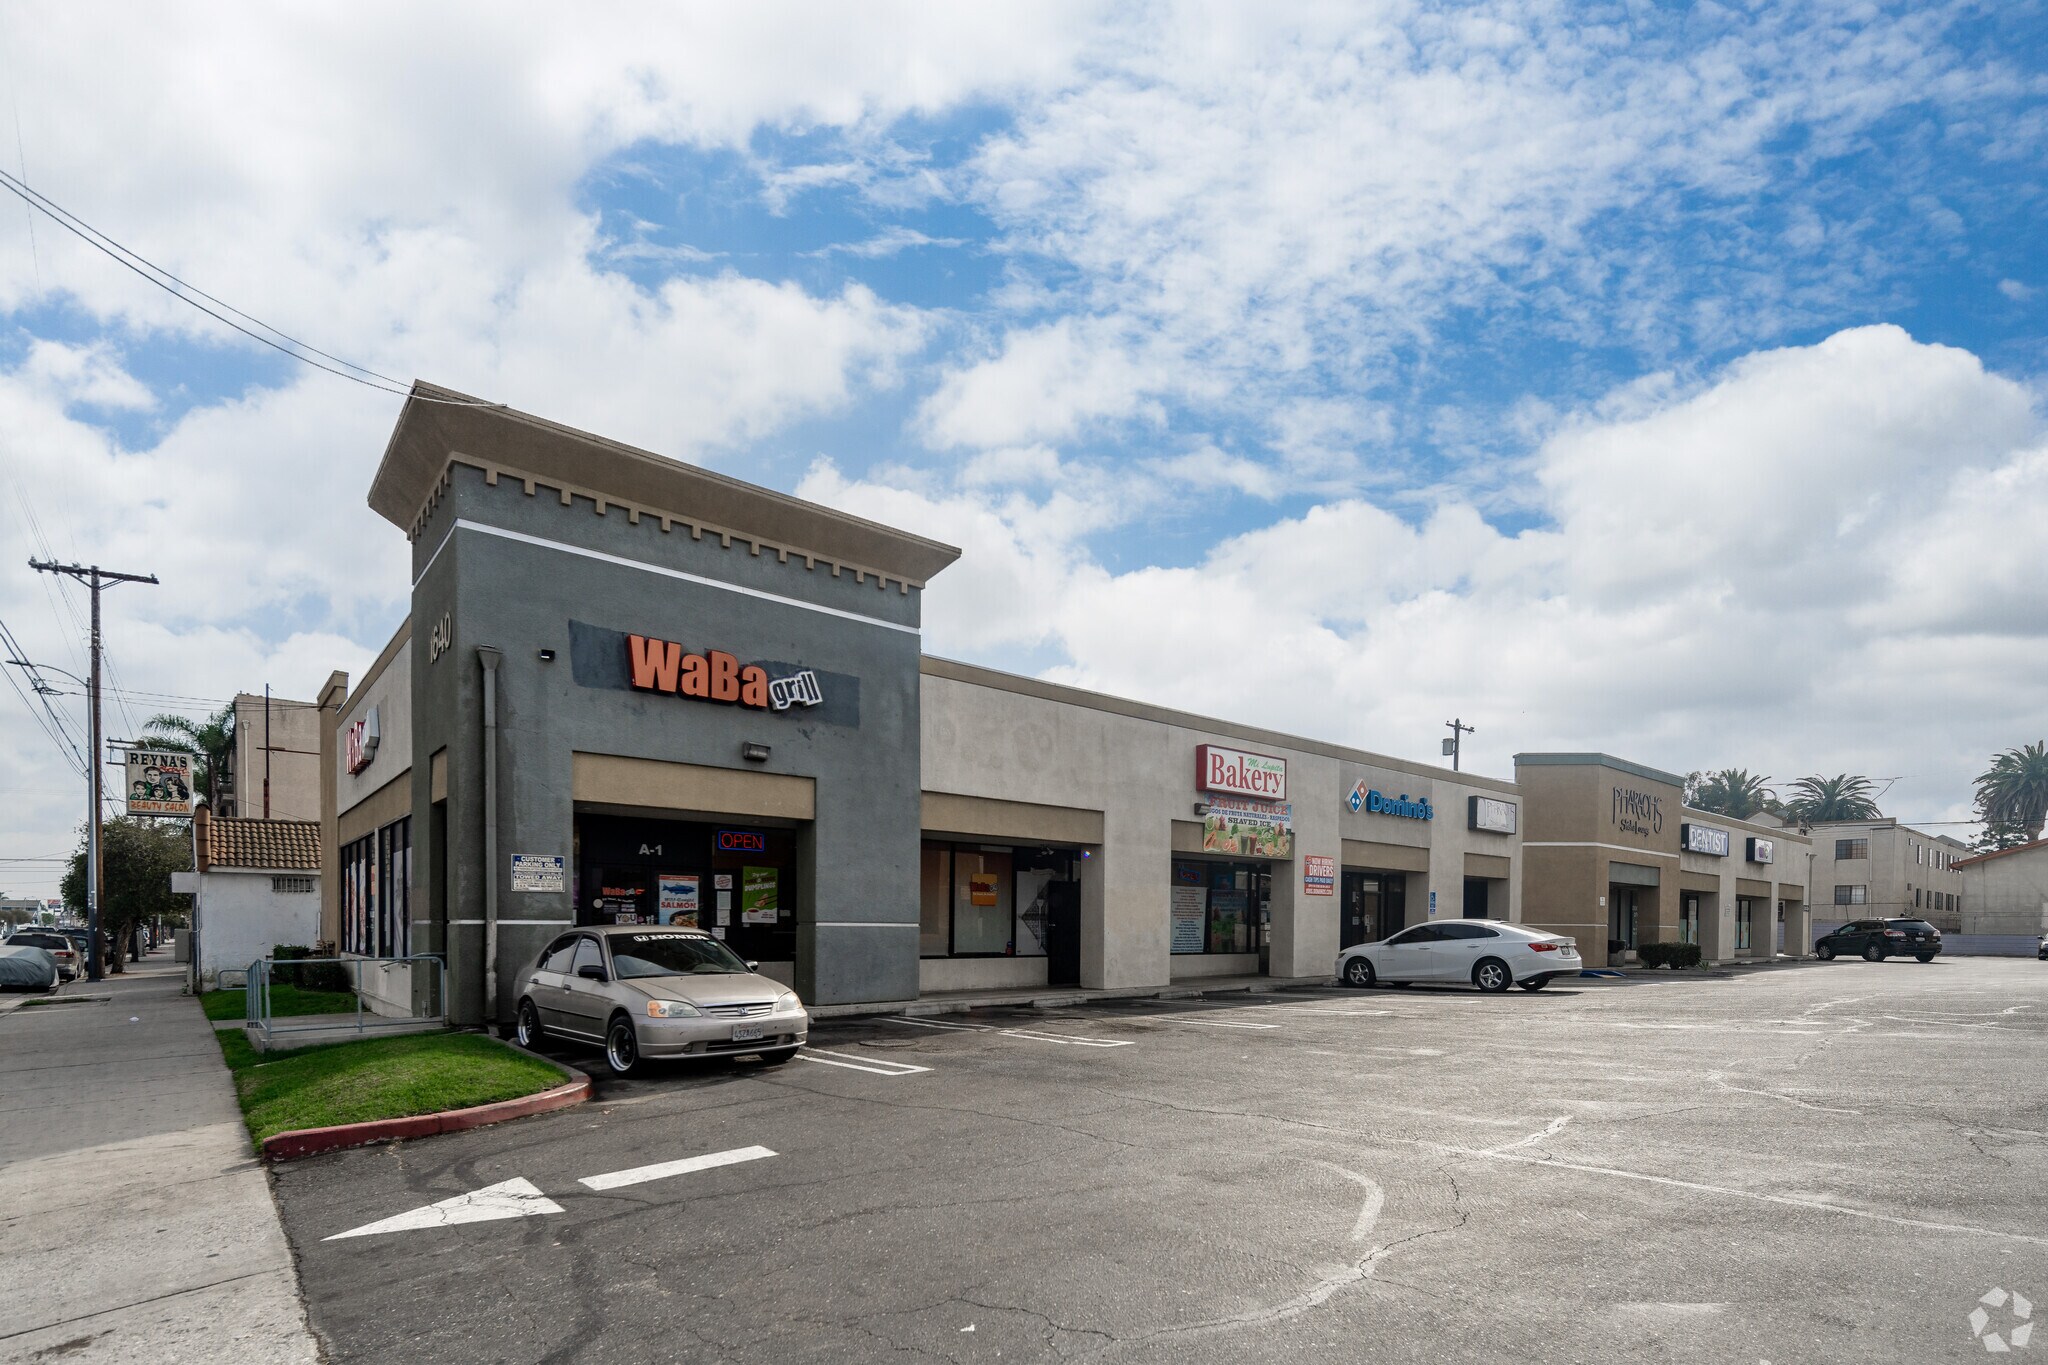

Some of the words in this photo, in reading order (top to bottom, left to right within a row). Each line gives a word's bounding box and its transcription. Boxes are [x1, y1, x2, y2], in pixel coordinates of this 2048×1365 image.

[430, 611, 450, 663] 1640
[627, 634, 768, 708] WaBa
[769, 671, 823, 710] grill
[129, 753, 188, 768] REYNA'S
[1247, 758, 1260, 767] Mi
[1261, 762, 1283, 772] Lupita
[1210, 753, 1284, 794] Bakery
[130, 801, 162, 810] BEAUTY
[164, 803, 189, 812] SALON
[1209, 796, 1250, 811] FRUIT
[1252, 801, 1289, 816] JUICE
[1368, 789, 1434, 821] Domino's
[1227, 817, 1258, 826] SHAVED
[1260, 820, 1272, 828] ICE
[721, 832, 763, 849] OPEN
[1690, 829, 1727, 852] DENTIST
[639, 843, 662, 856] A-1
[1310, 864, 1333, 877] DRIVERS
[661, 901, 697, 909] SALMON
